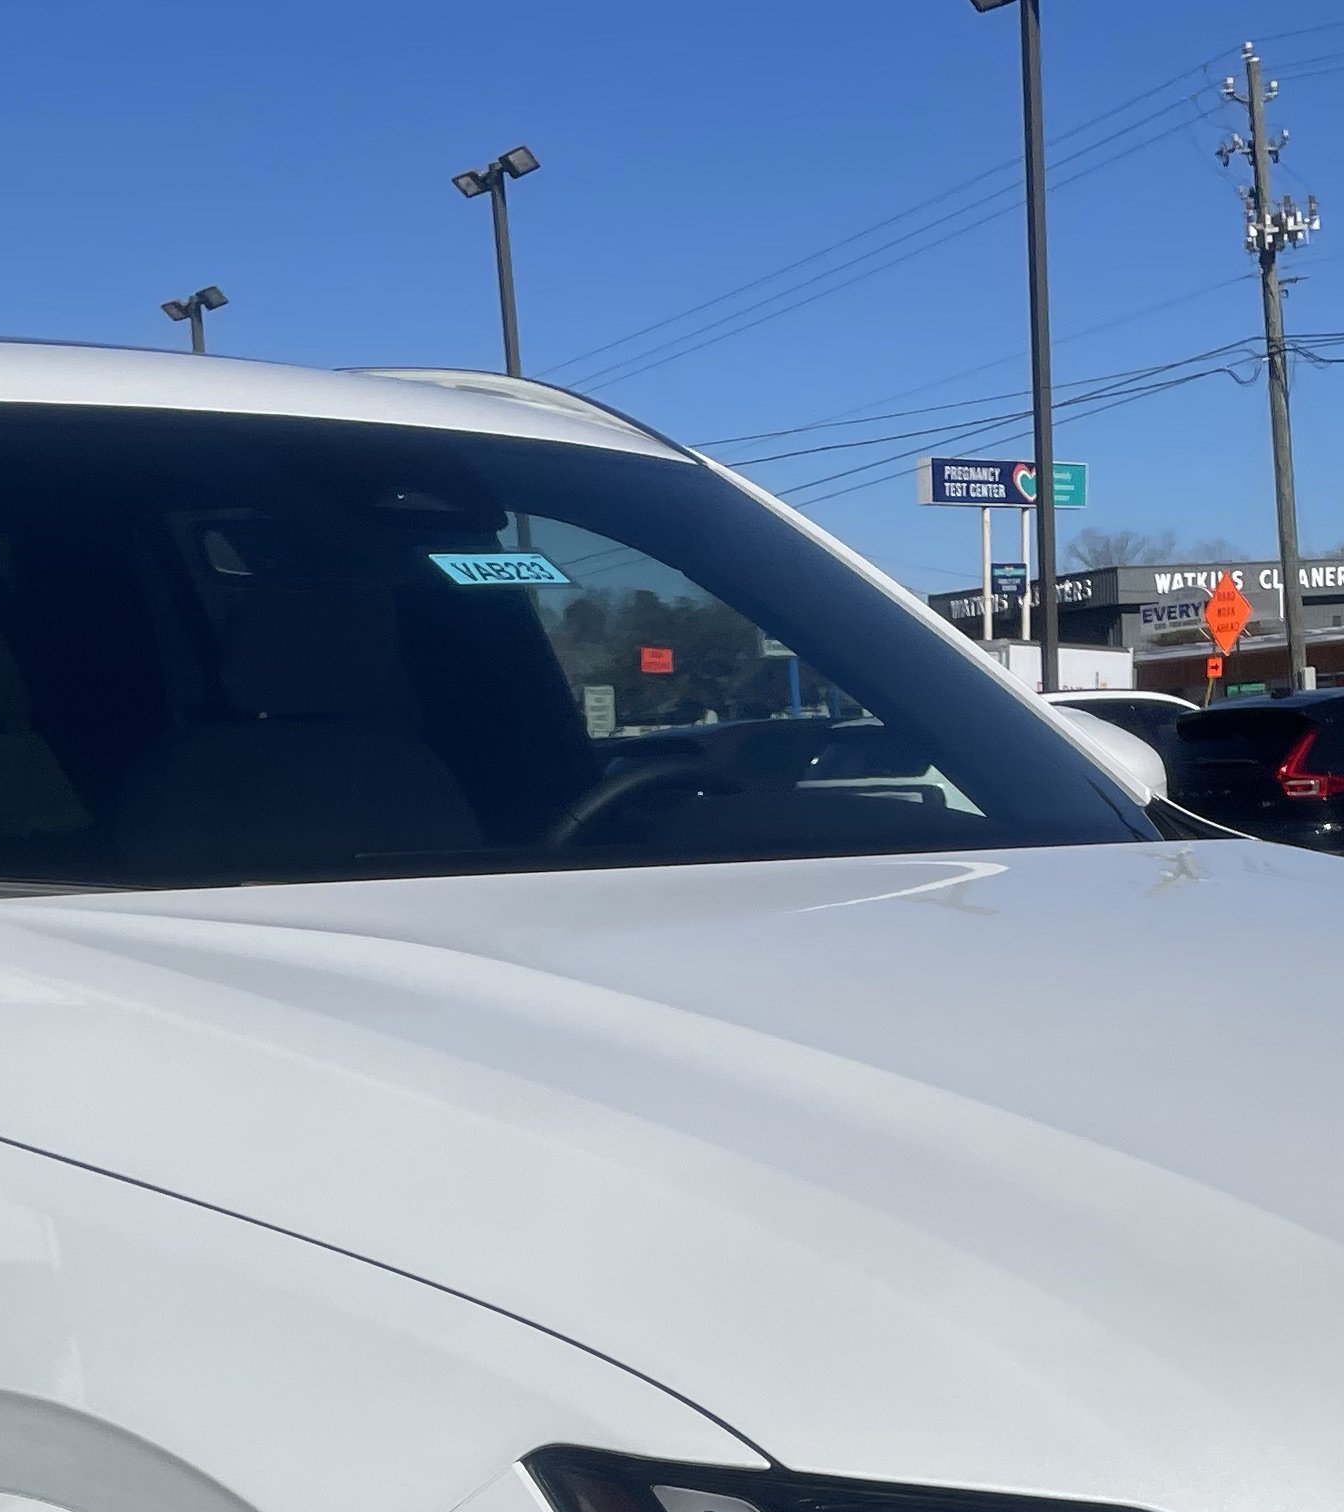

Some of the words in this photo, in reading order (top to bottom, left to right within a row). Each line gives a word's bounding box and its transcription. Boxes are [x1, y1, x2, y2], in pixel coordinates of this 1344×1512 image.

[944, 465, 1001, 482] PREGNANCY
[944, 482, 968, 497] TEST
[969, 483, 1006, 498] CENTER
[450, 561, 556, 581] VAB233
[1155, 569, 1244, 594] WATKIS
